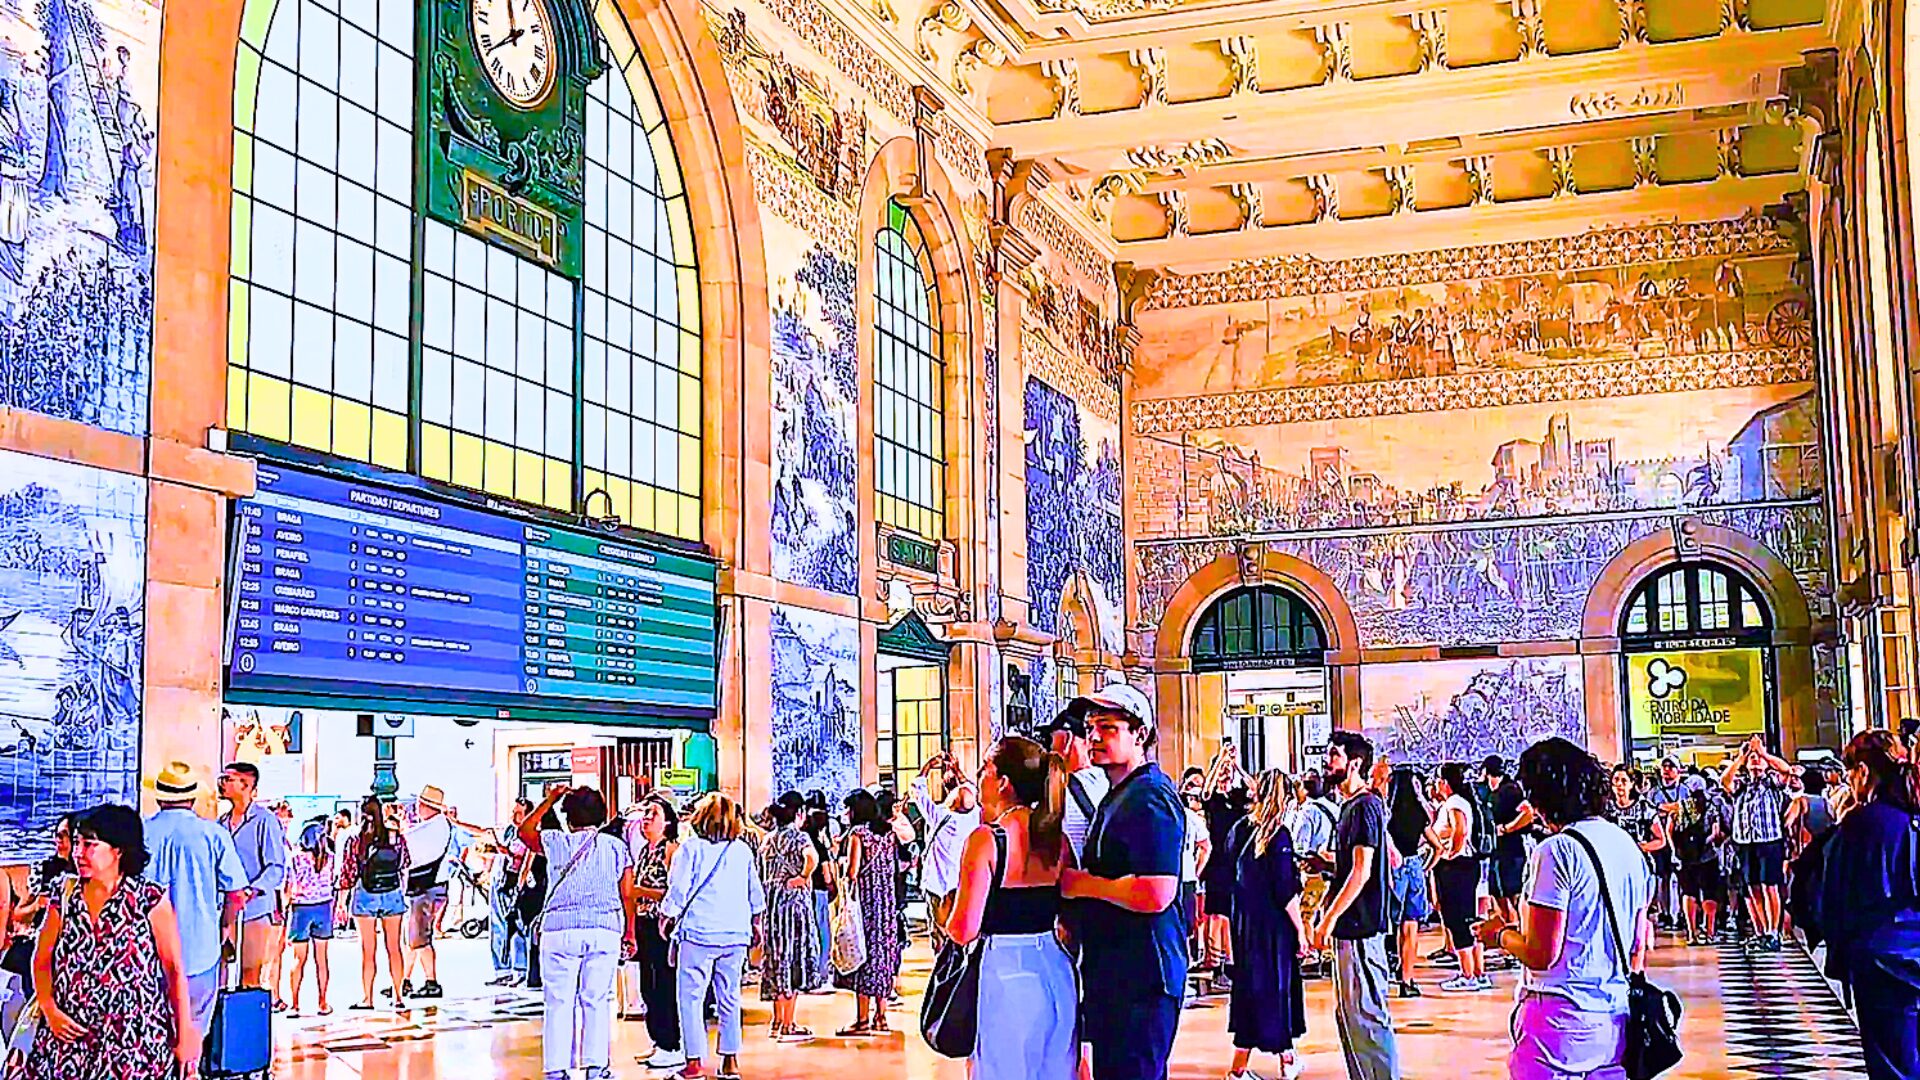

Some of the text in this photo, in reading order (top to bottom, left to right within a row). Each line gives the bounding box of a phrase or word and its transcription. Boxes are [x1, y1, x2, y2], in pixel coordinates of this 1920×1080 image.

[479, 188, 543, 242] PORTO
[350, 490, 388, 508] PARTIDAS
[393, 501, 440, 519] DEPARTURES
[1642, 699, 1688, 712] CENTRO
